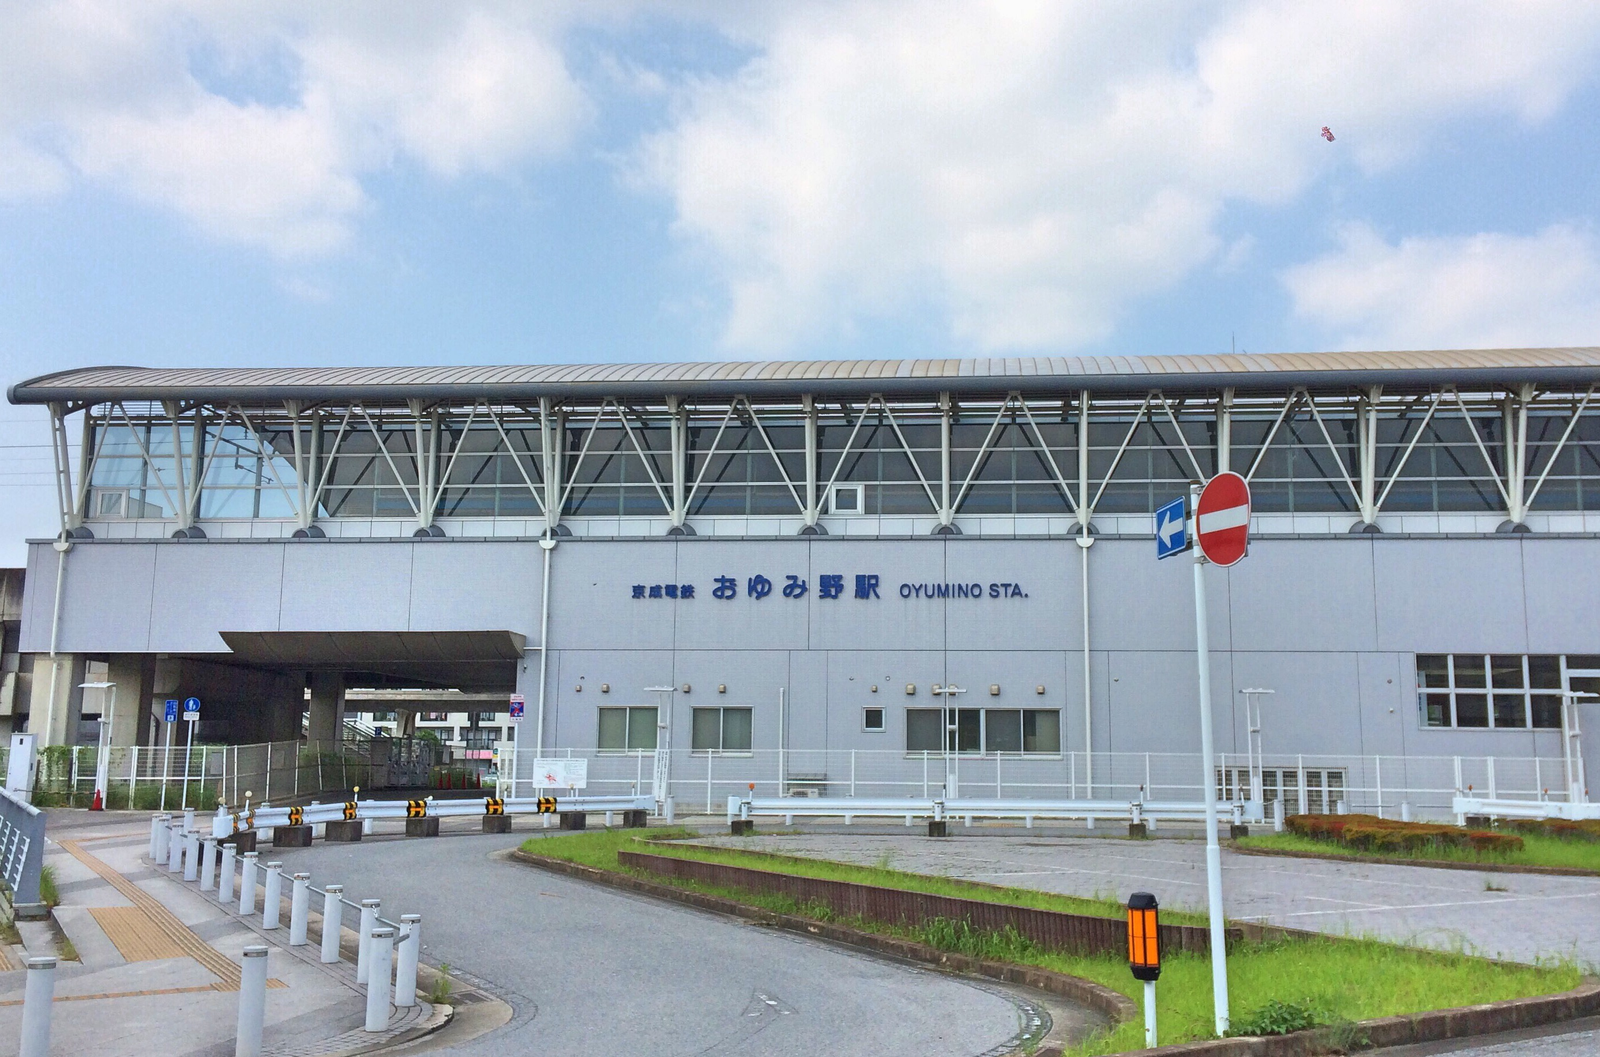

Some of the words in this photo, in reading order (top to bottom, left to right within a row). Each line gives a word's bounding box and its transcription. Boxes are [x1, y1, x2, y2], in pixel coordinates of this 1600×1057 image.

[632, 584, 696, 600] 京成電鉄
[712, 574, 881, 601] おゆみ野駅
[900, 583, 983, 600] OYUMINO
[988, 583, 1029, 600] STA.
